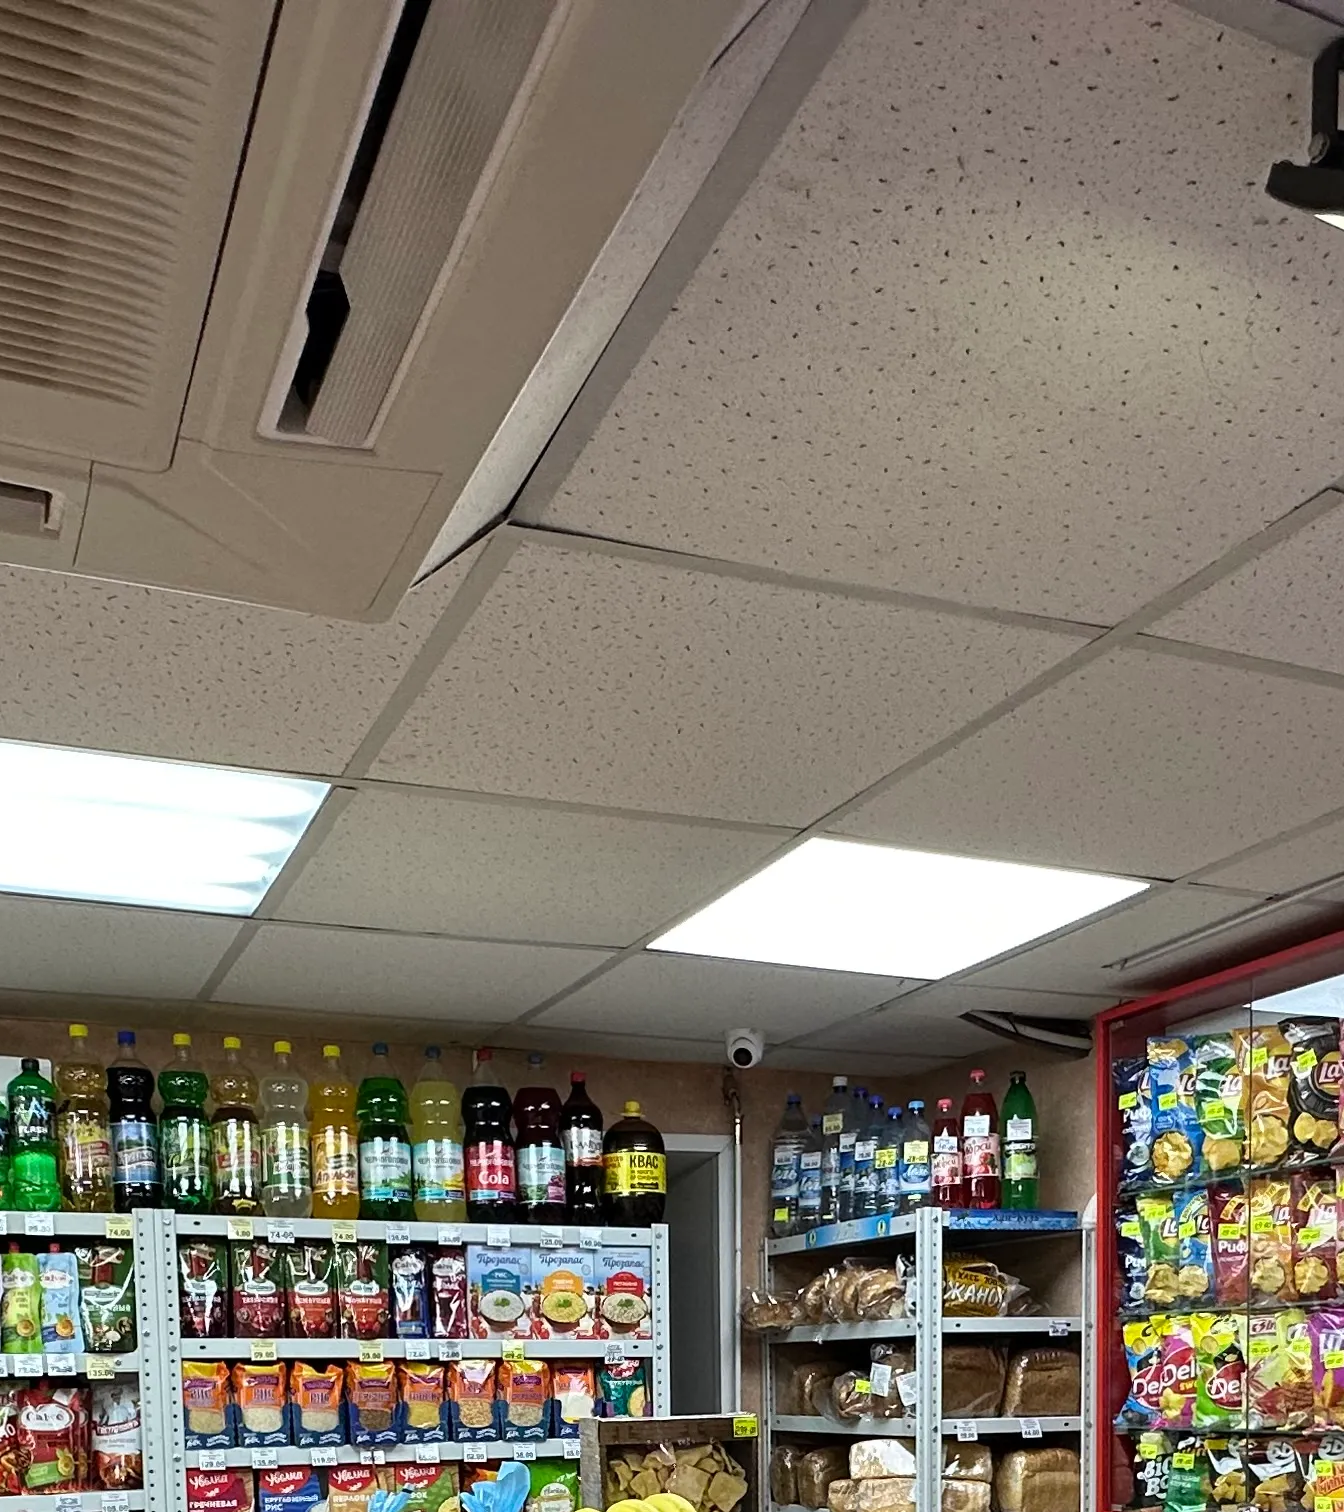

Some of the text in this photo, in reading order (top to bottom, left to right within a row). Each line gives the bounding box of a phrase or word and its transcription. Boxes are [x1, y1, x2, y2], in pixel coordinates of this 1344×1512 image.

[629, 1155, 659, 1169] КВАС
[478, 1170, 509, 1185] Cola
[539, 1253, 584, 1266] Прозапас
[265, 1472, 303, 1486] Увелка
[333, 1469, 369, 1480] Увелка
[400, 1468, 437, 1479] Увелка
[189, 1475, 227, 1487] Увелка
